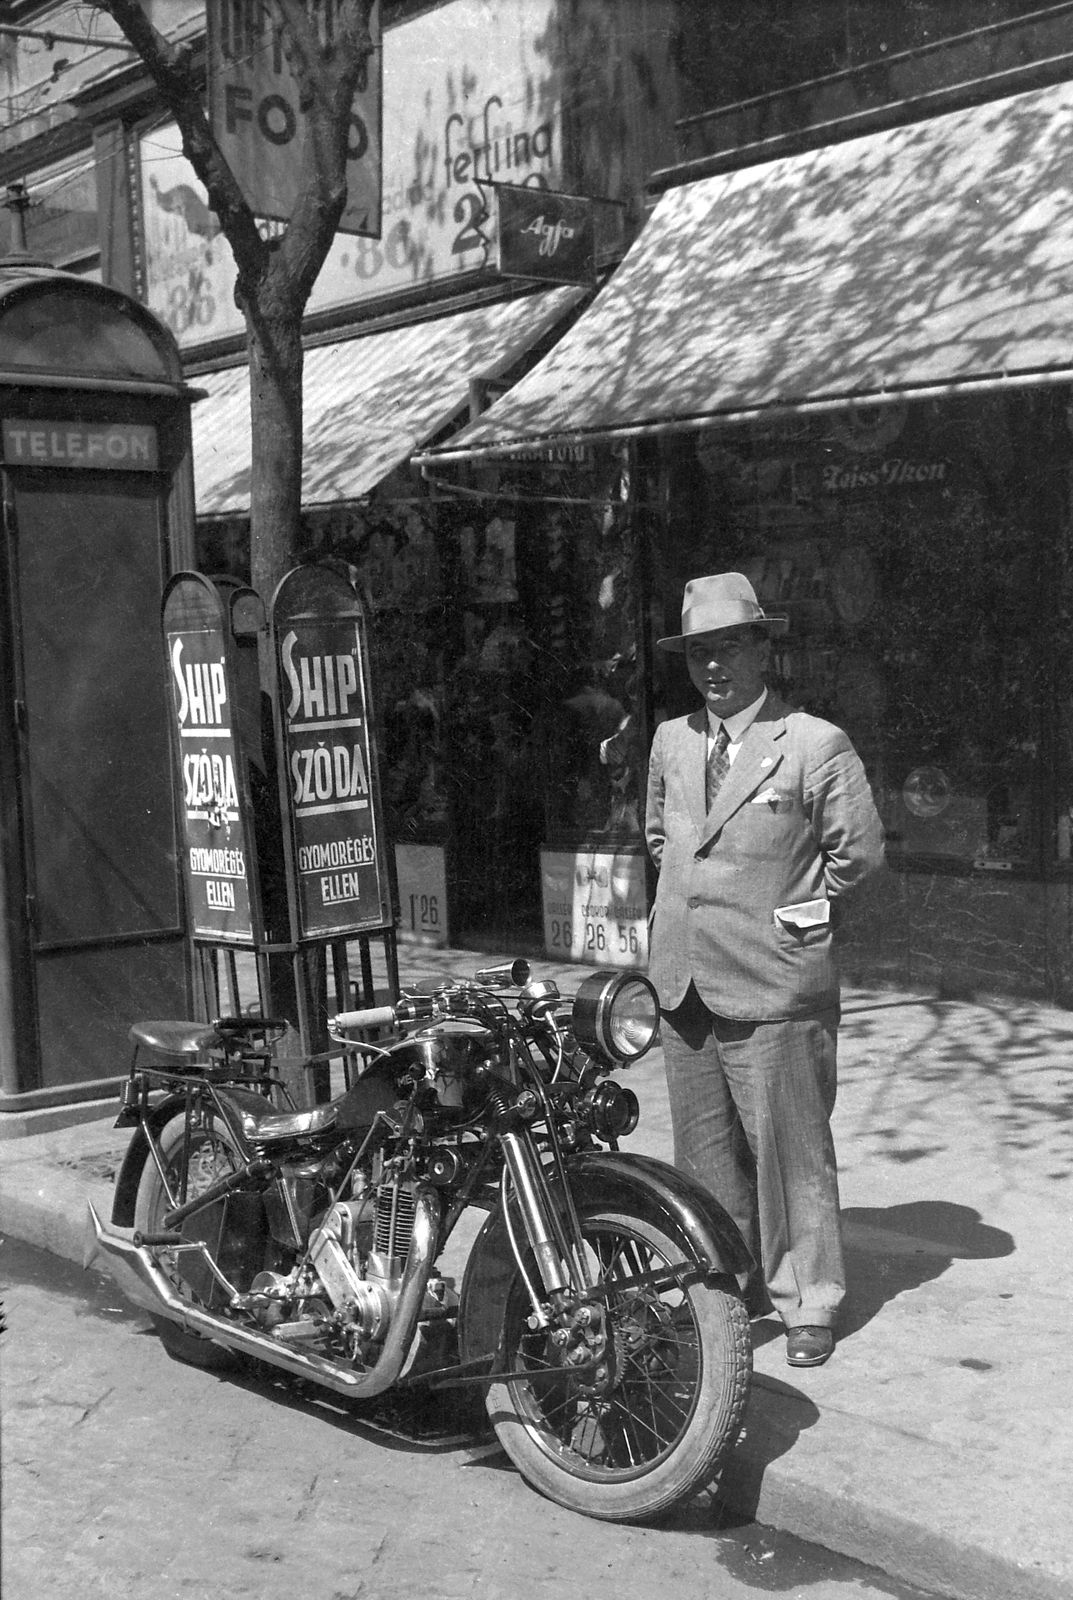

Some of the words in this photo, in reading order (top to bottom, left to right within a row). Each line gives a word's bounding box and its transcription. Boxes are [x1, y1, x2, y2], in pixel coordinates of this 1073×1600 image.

[225, 84, 368, 161] FOO
[518, 215, 574, 257] Agfa
[8, 430, 150, 460] TELEFON
[189, 846, 246, 876] GYOMORÉGÉS
[298, 834, 375, 870] GYOMORÉGÉS
[206, 880, 236, 907] ELLEN
[320, 872, 360, 902] ELLEN
[551, 919, 572, 948] 26
[587, 923, 606, 951] 26
[618, 924, 638, 954] 56
